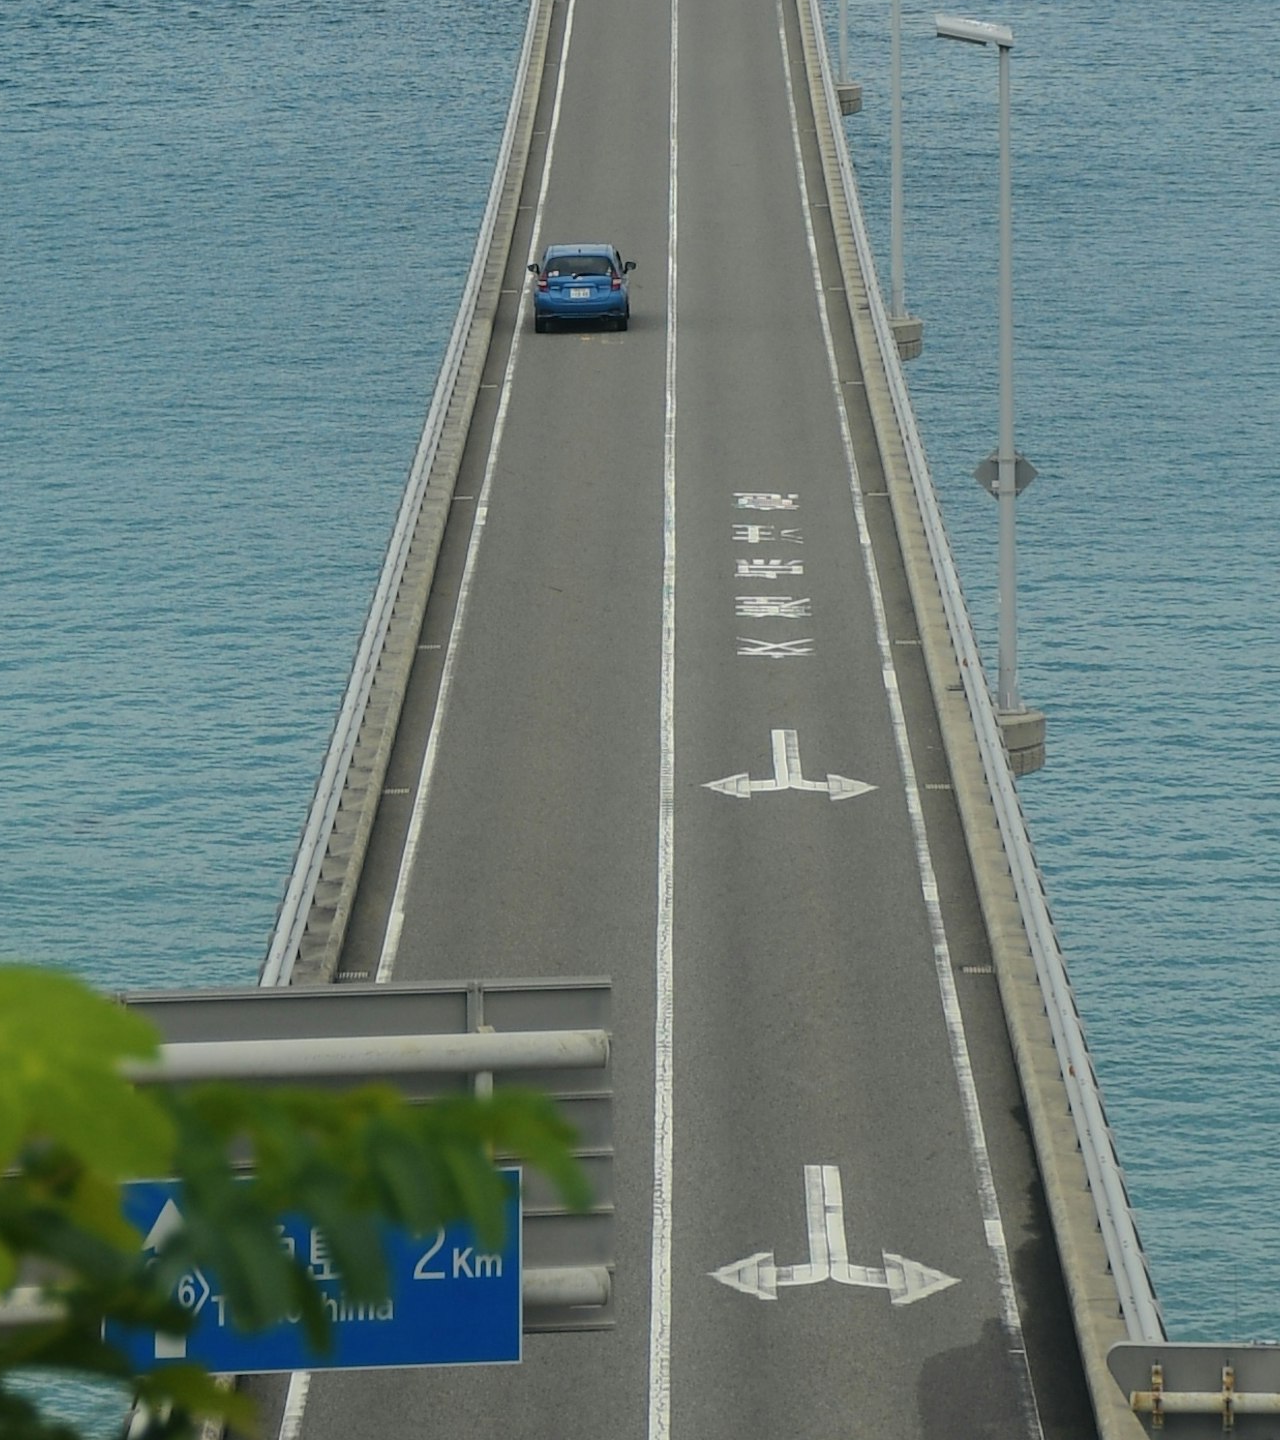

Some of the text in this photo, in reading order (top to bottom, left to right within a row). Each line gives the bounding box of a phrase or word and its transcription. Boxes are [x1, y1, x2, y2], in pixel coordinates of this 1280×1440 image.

[732, 492, 816, 658] 交差点注意
[413, 1225, 446, 1280] 2
[452, 1247, 503, 1279] Km
